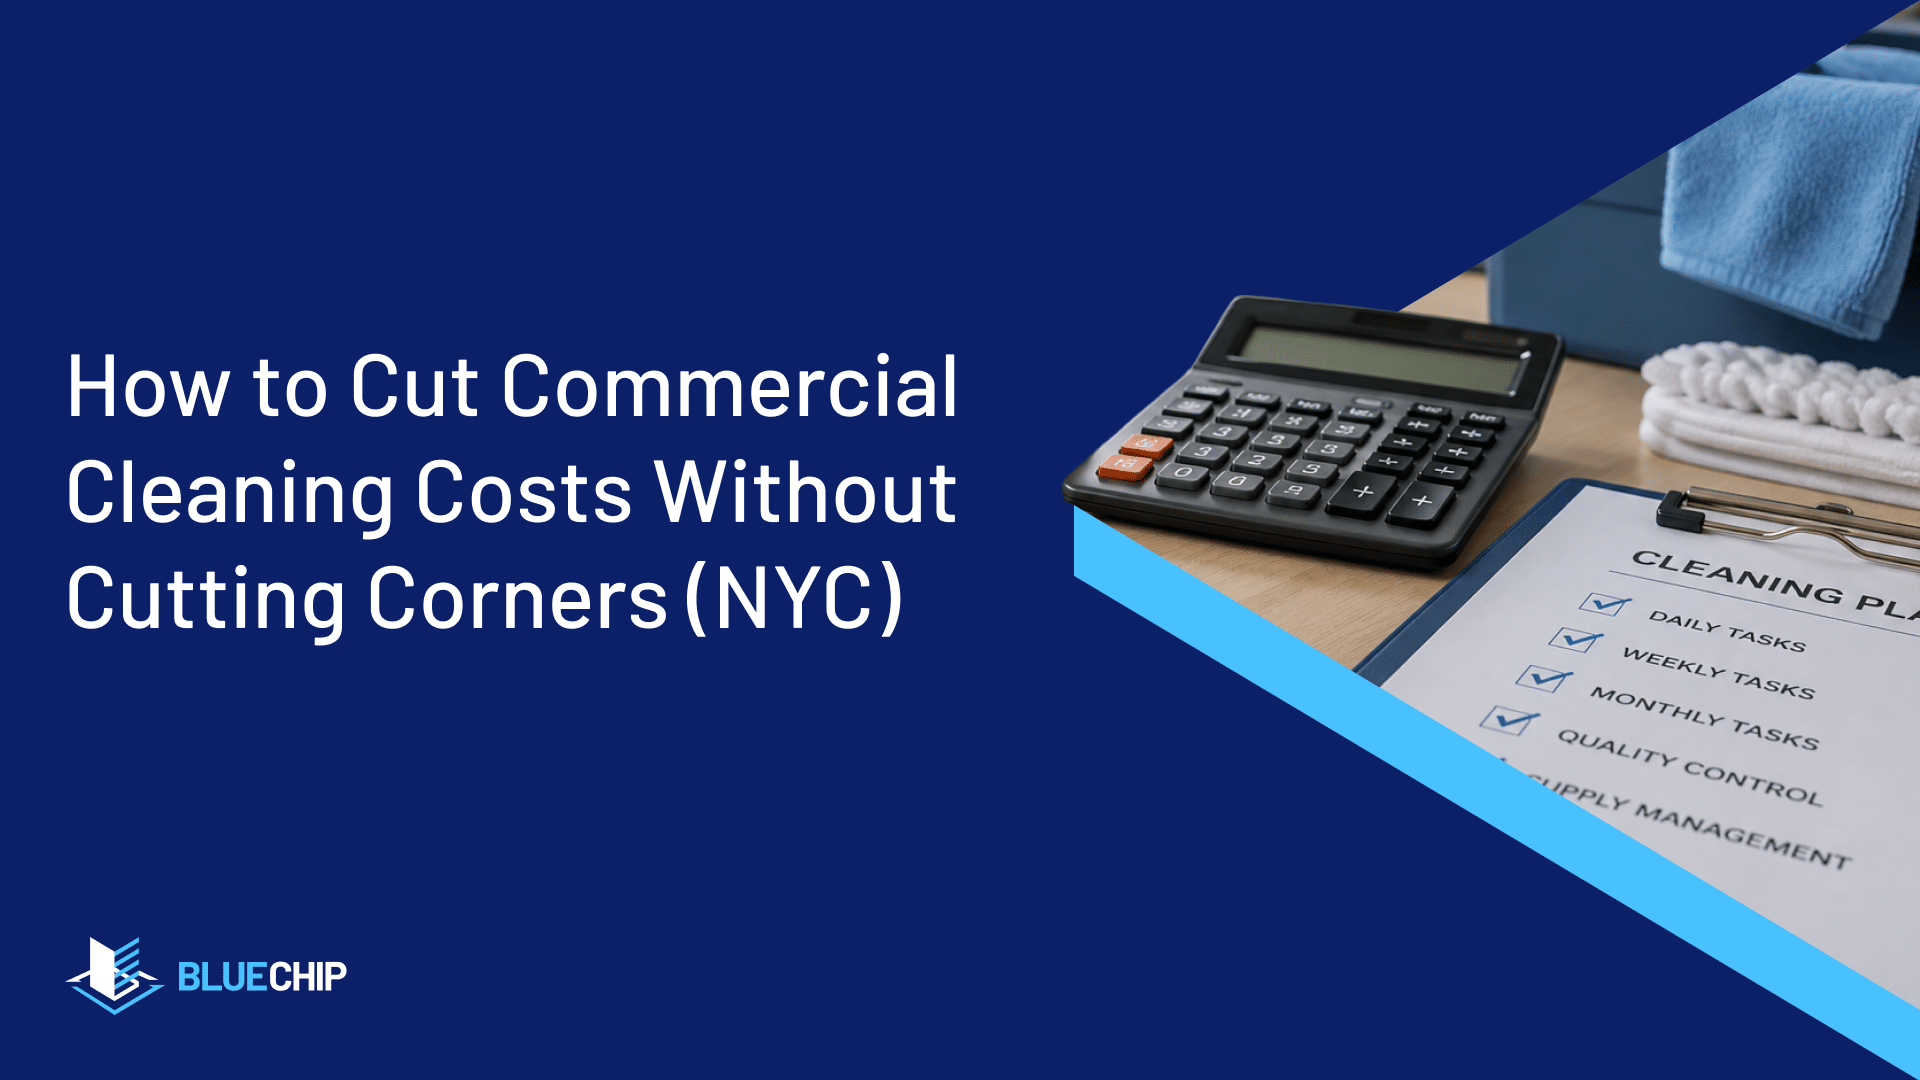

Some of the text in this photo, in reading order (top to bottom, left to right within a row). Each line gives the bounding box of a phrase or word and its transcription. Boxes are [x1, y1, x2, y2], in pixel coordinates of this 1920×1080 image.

[1632, 550, 1844, 605] CLEANING
[1649, 610, 1807, 653] DAILY TASKS
[1623, 647, 1816, 700] WEEKLY TASKS
[1590, 686, 1821, 751] MONTHLY TASKS
[1558, 729, 1824, 808] QUALITY CONTROL
[1634, 803, 1853, 872] MANAGEMENT
